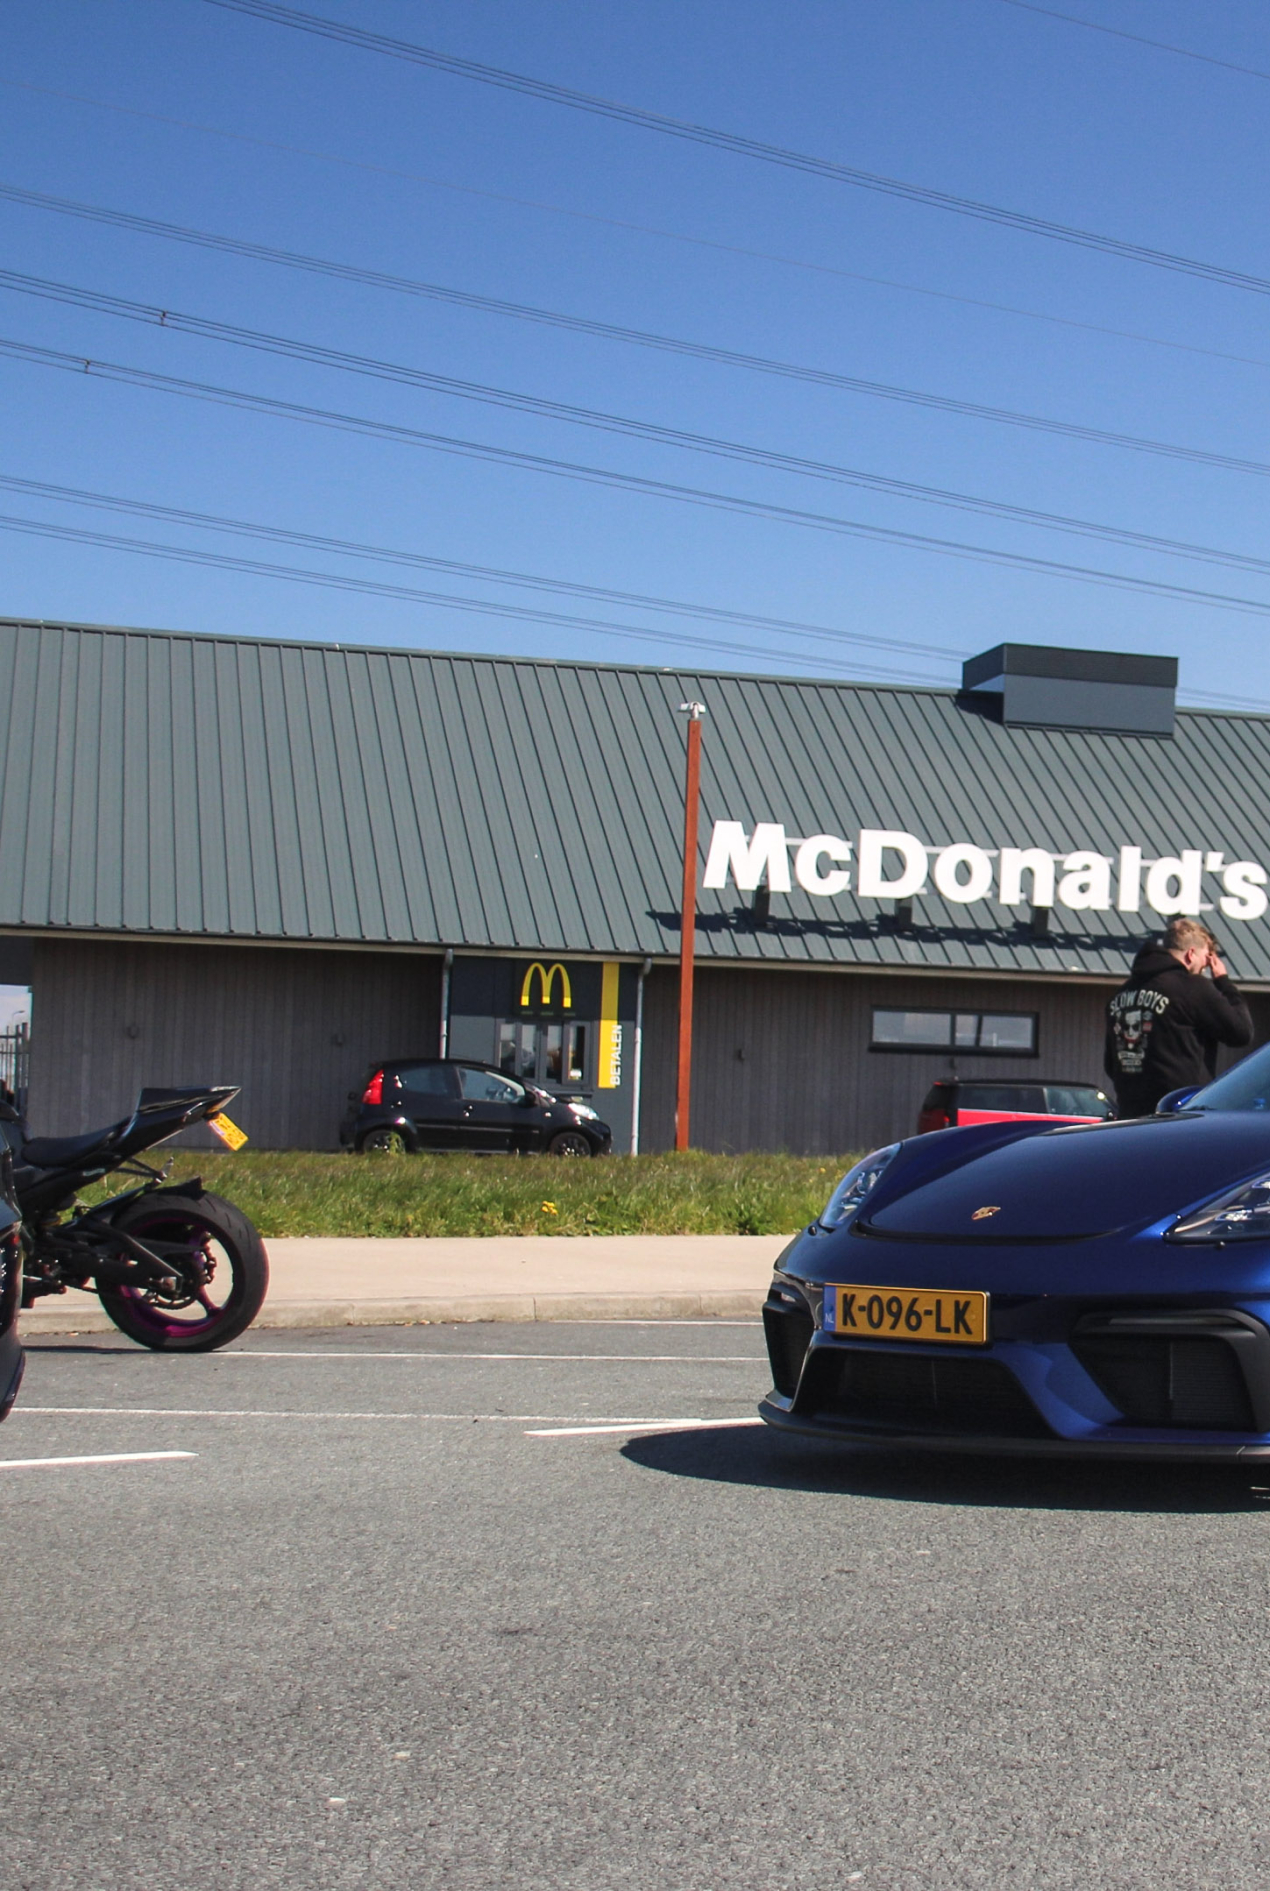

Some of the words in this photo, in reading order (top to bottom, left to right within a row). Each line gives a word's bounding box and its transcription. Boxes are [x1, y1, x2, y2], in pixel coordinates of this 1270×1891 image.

[703, 820, 1268, 921] McDonald's
[1109, 990, 1137, 1016] SLOW
[1137, 989, 1170, 1014] BOYS
[609, 1024, 623, 1087] BETALEN
[824, 1313, 835, 1324] NL
[842, 1293, 973, 1335] K-096-LK
